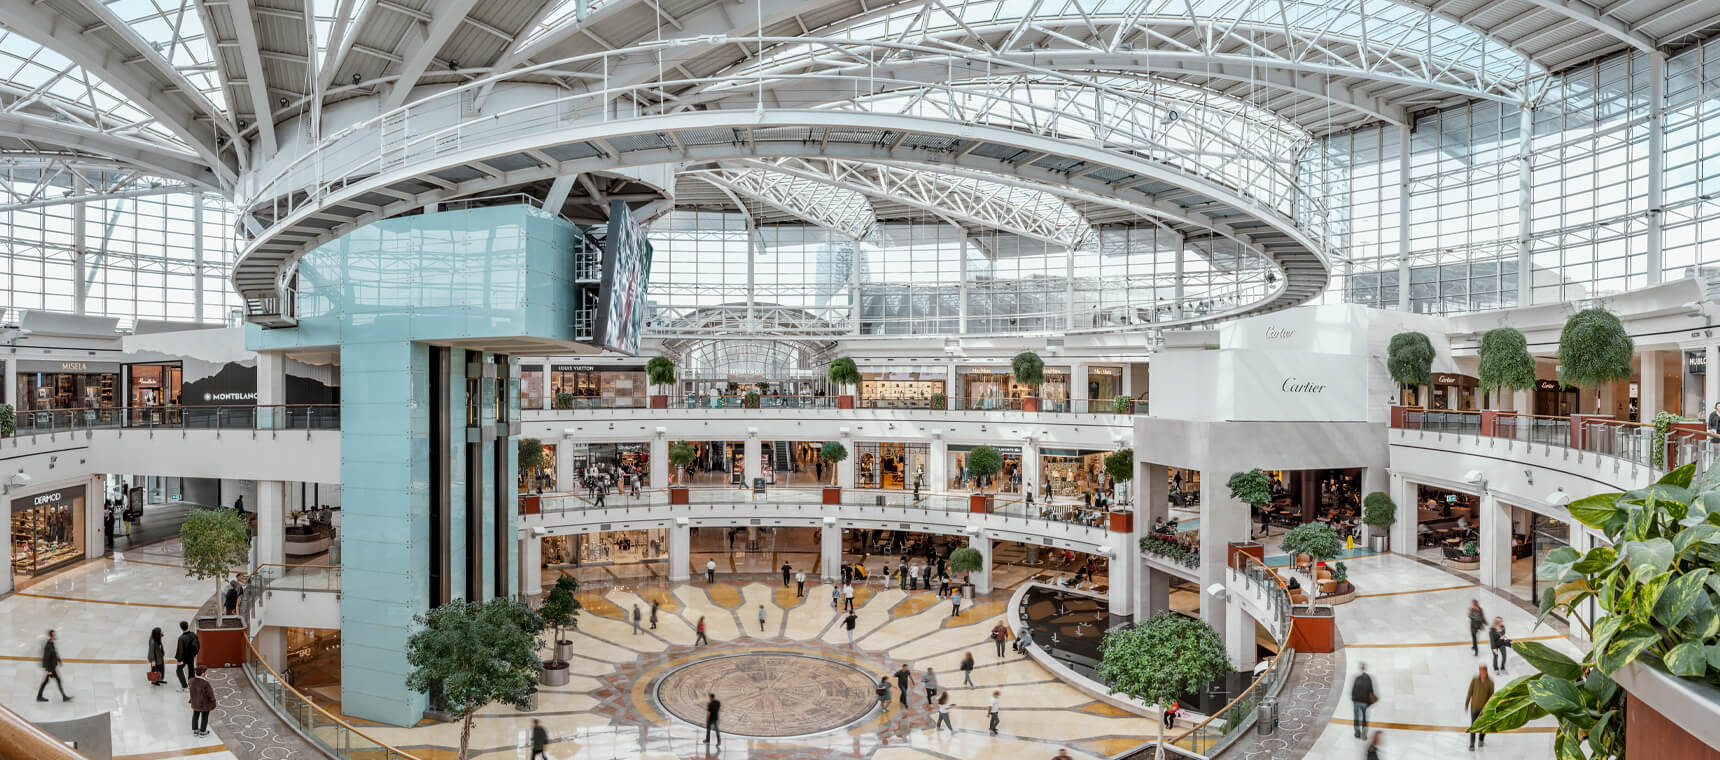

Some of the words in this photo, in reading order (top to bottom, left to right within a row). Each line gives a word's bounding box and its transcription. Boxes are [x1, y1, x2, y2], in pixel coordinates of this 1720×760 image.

[1265, 326, 1297, 338] Cartier
[62, 362, 87, 370] MISELA
[1282, 377, 1327, 393] Cartier
[1438, 375, 1456, 383] Cartier
[34, 493, 61, 505] DERMOD
